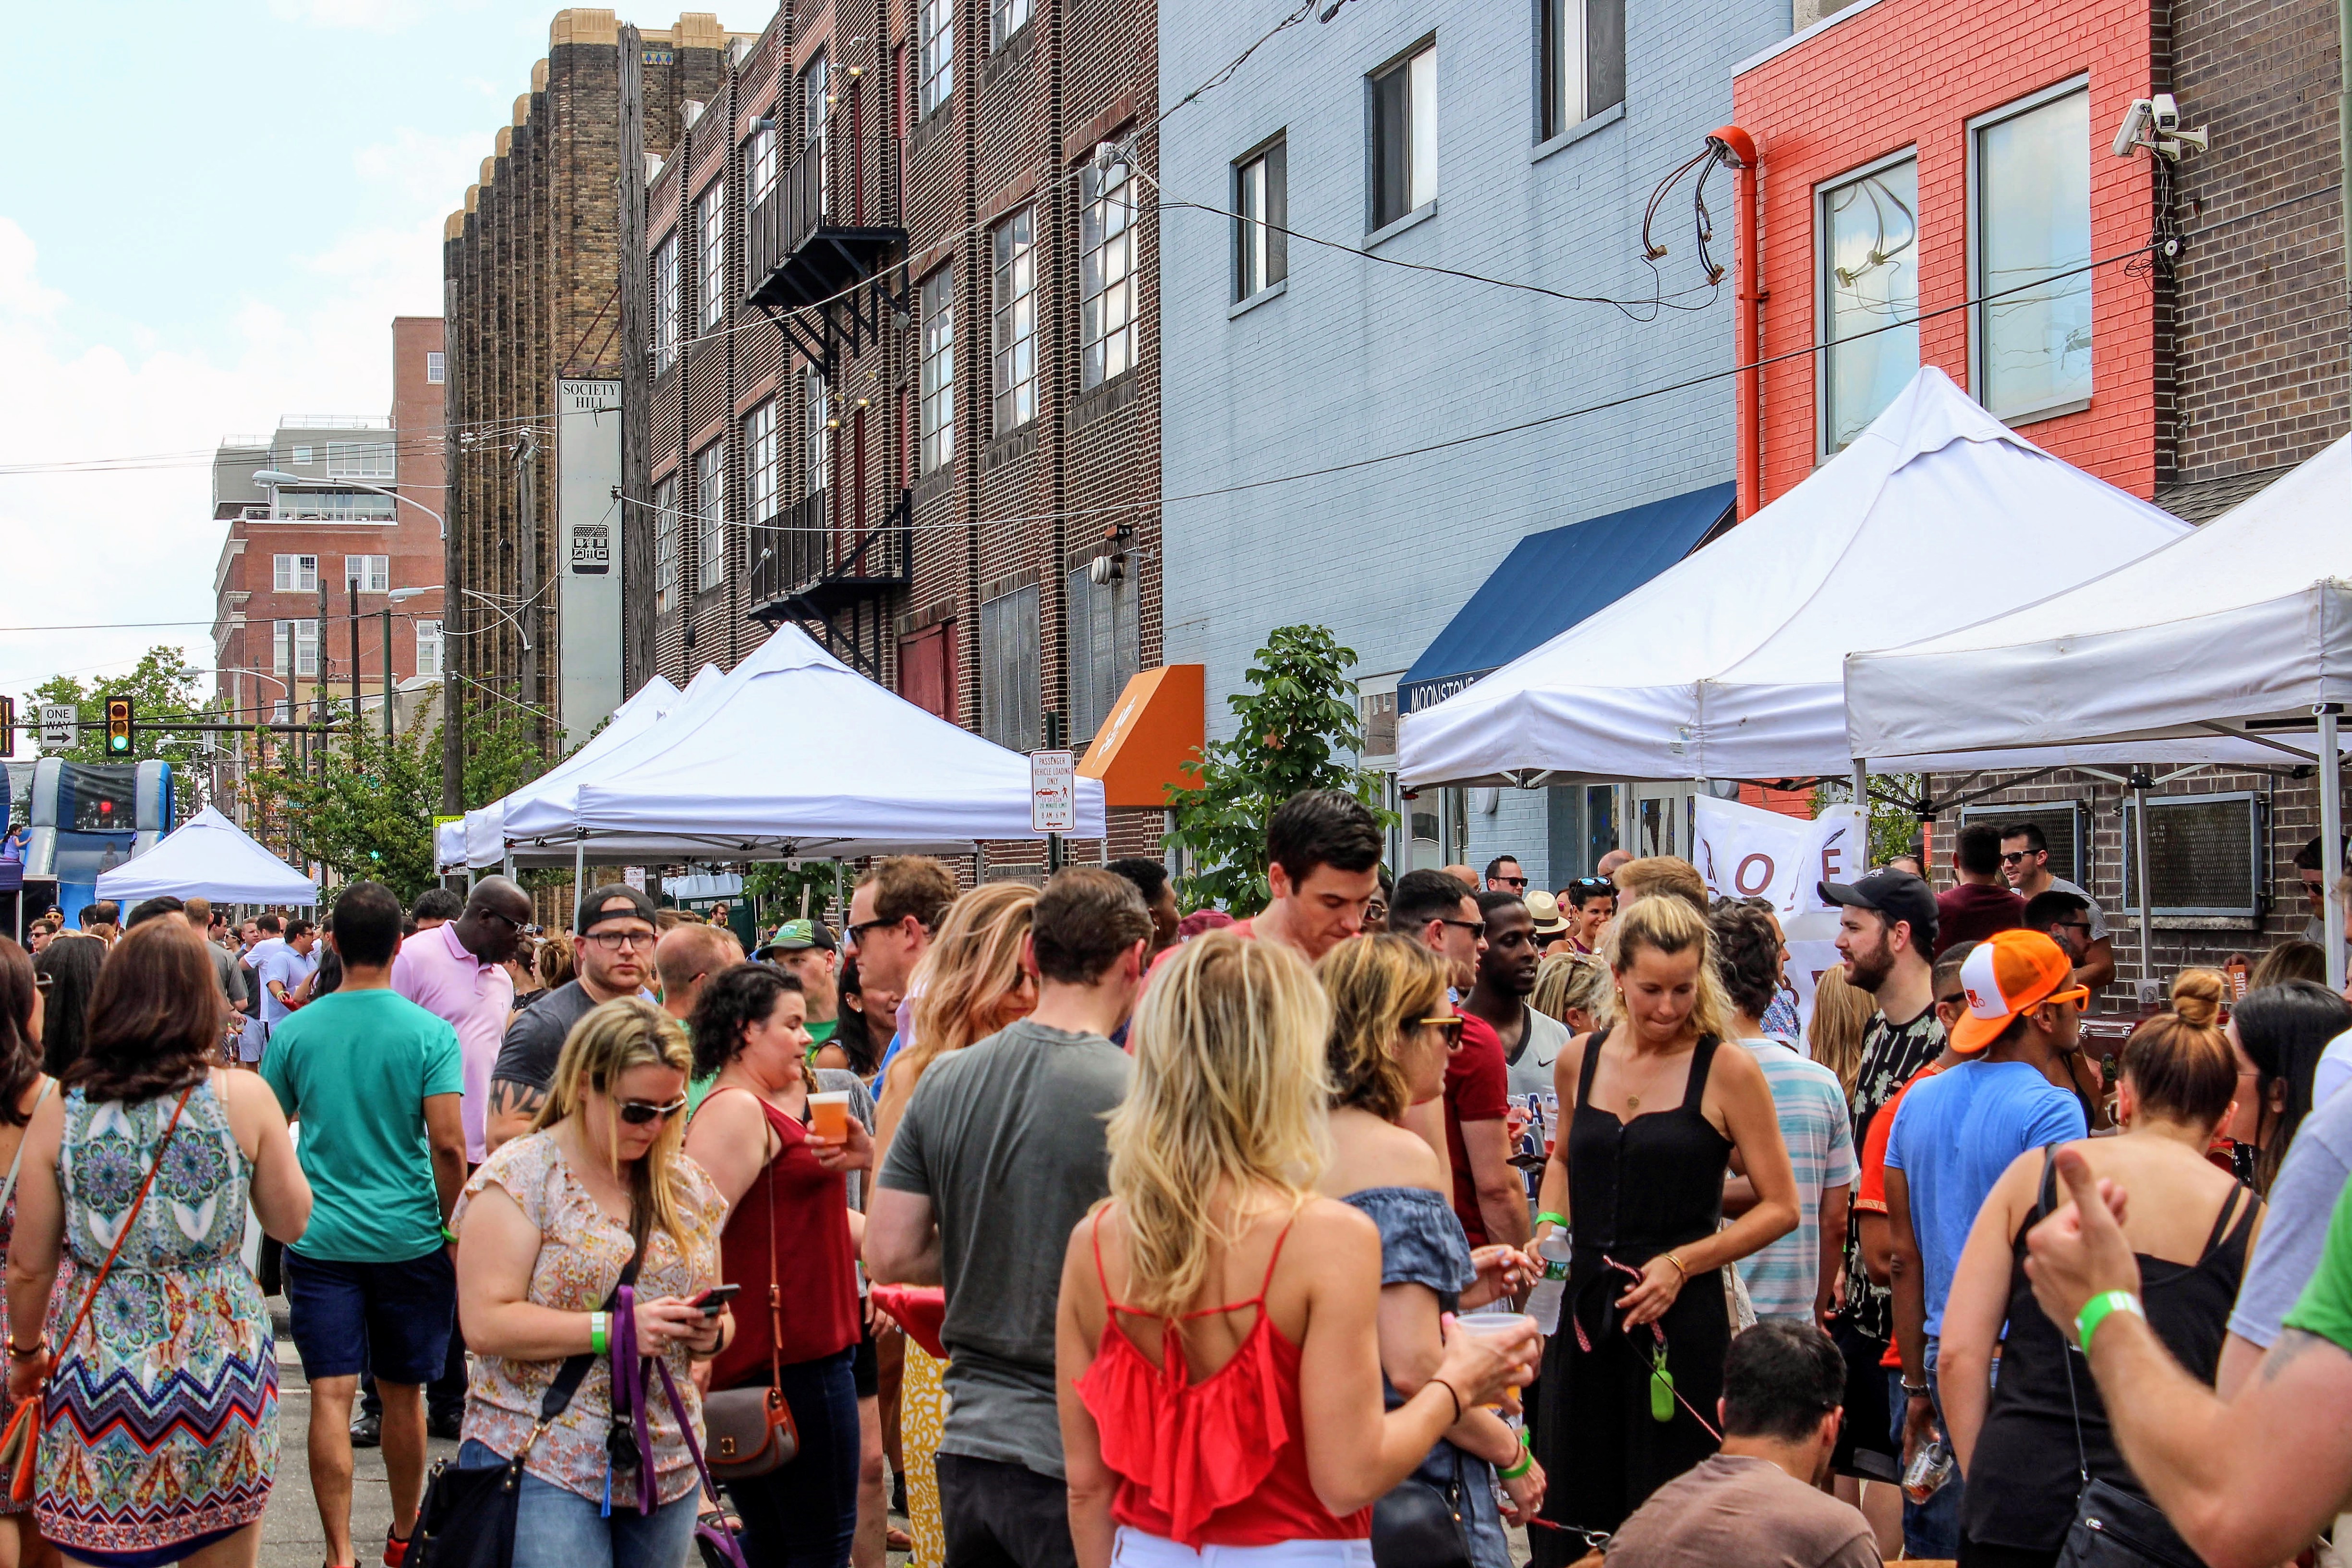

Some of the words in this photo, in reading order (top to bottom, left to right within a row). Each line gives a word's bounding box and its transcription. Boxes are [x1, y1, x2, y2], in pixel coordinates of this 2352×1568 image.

[563, 384, 617, 395] SOCIETY
[576, 397, 606, 408] HILL
[47, 709, 70, 718] ONE
[47, 721, 70, 730] WAY
